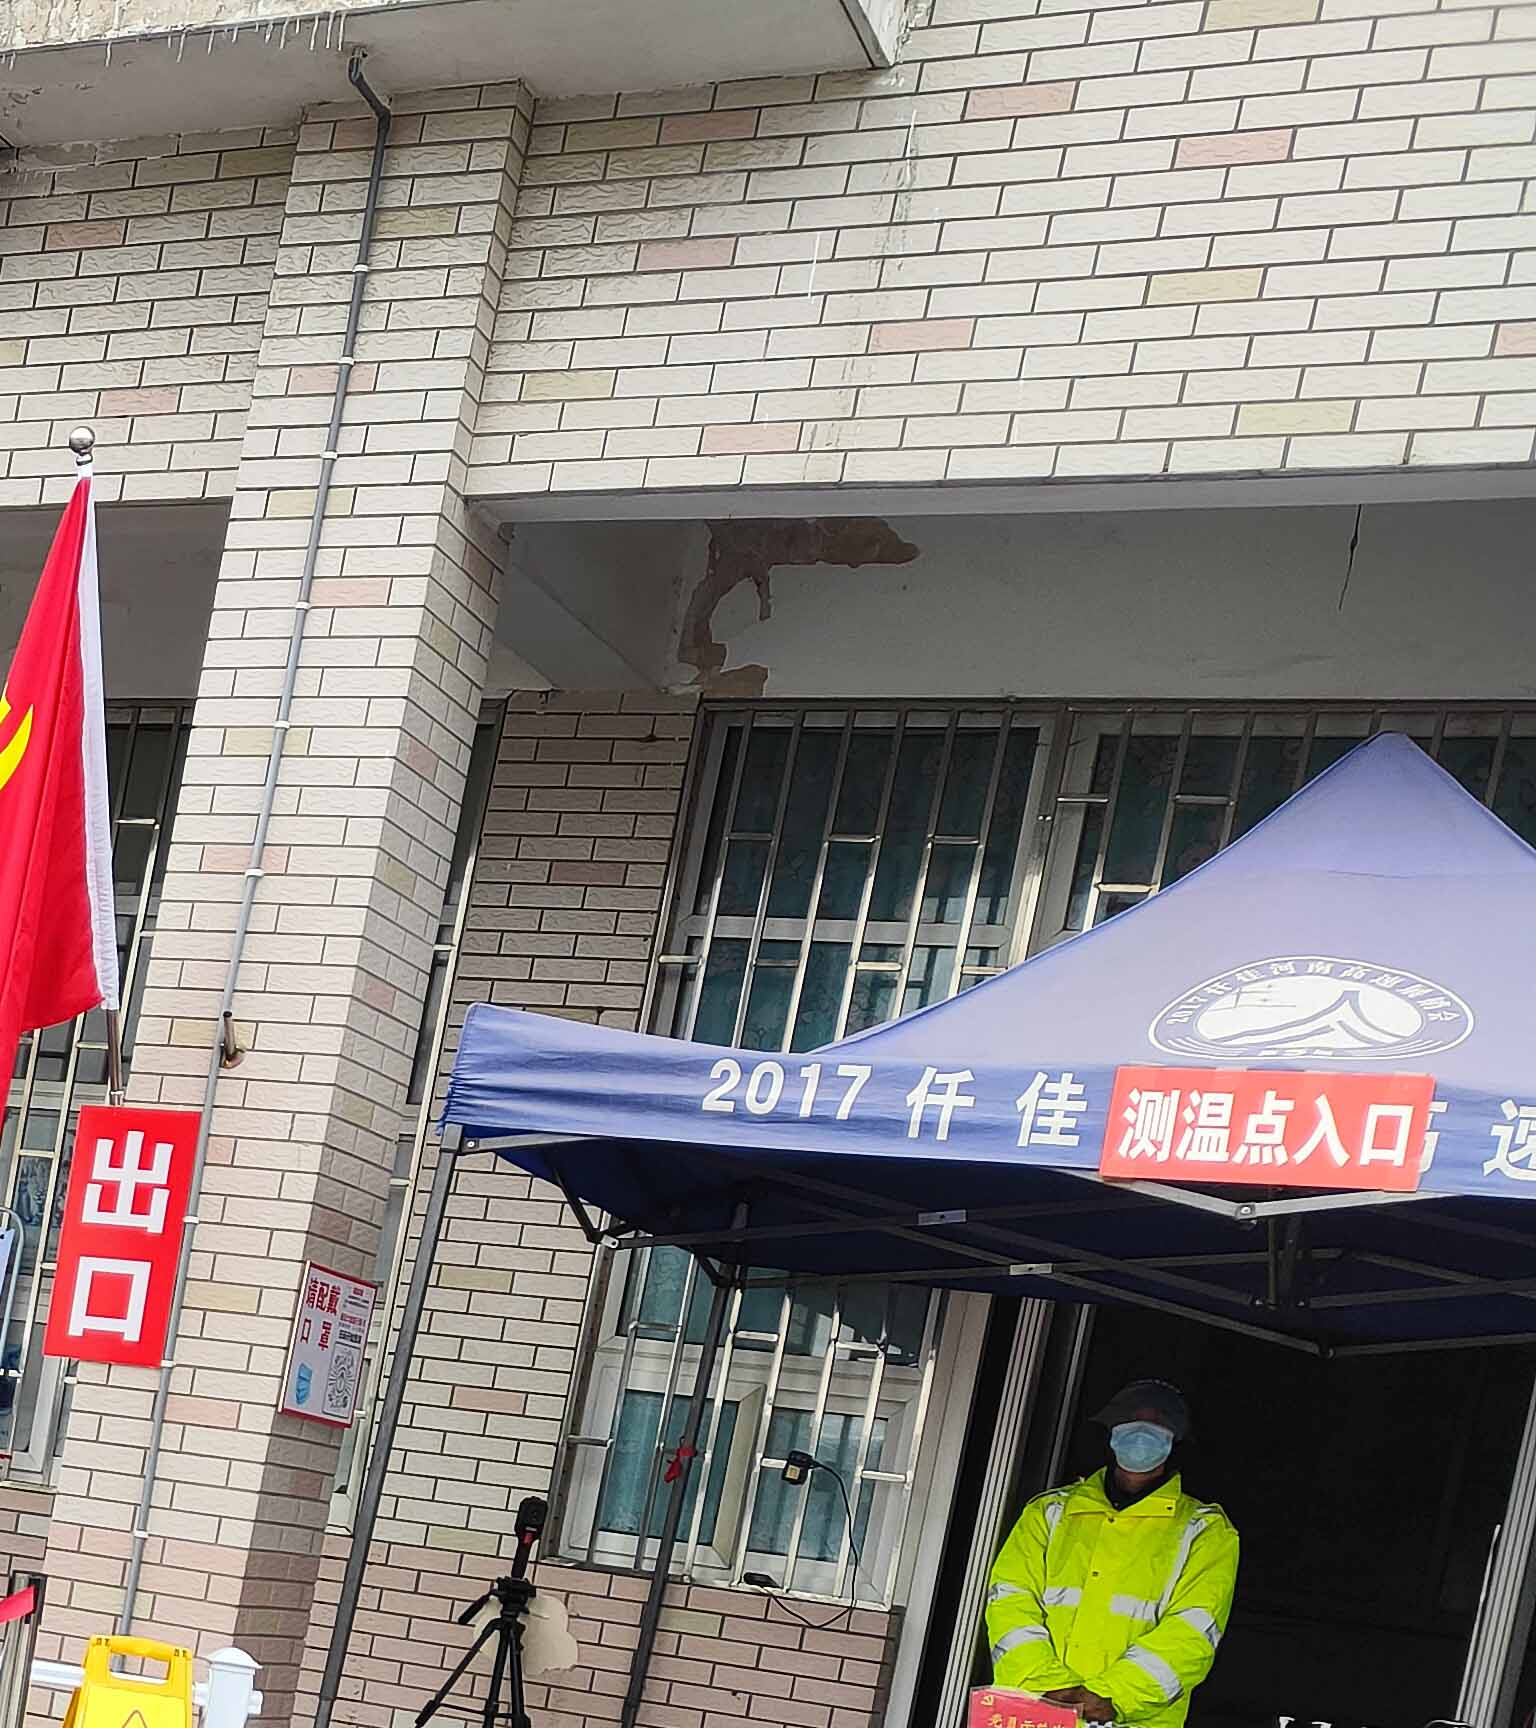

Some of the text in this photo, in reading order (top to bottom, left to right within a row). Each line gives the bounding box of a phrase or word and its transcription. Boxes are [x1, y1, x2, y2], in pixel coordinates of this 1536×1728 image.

[702, 1058, 873, 1122] 2017
[1116, 1087, 1415, 1167] 测温点入口
[67, 1130, 174, 1343] 出口
